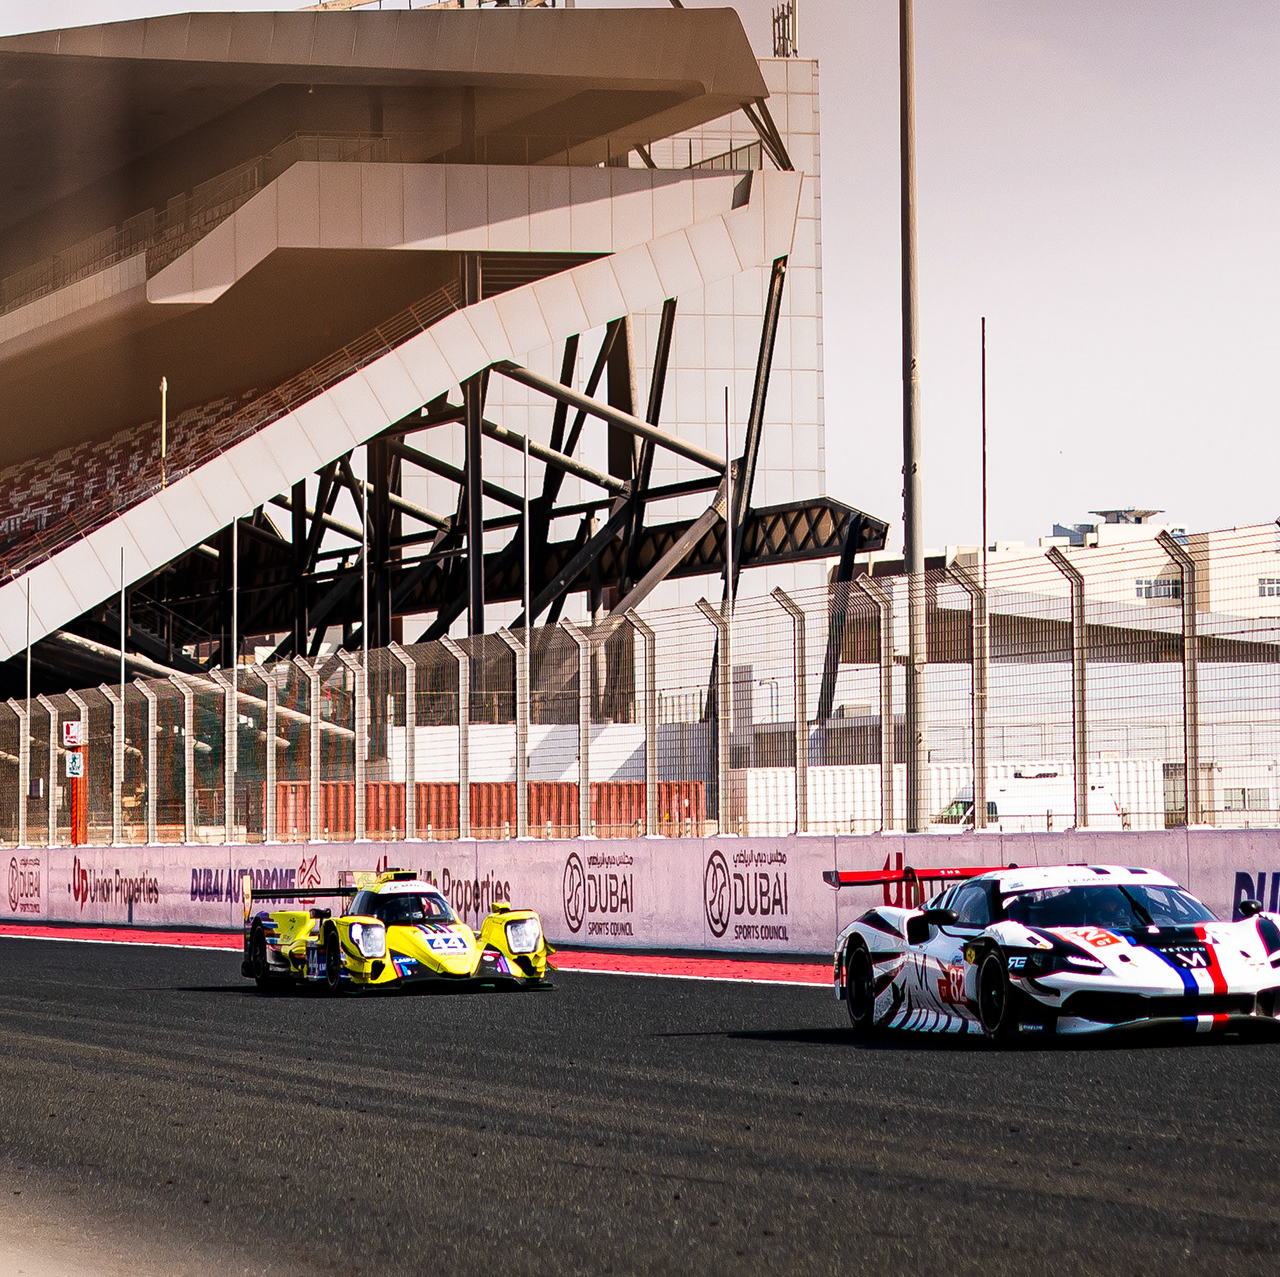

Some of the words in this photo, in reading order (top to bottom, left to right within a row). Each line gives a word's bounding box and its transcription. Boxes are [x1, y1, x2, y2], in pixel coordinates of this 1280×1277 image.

[89, 869, 112, 903] Union
[114, 868, 159, 908] Properties
[191, 868, 224, 902] DUBAI
[442, 868, 511, 923] Properties
[587, 873, 634, 913] DUBAI
[734, 872, 789, 916] DUBAI
[432, 937, 464, 950] 44
[587, 921, 609, 935] SPORTS
[610, 921, 634, 936] COUNCIL
[734, 924, 759, 940] SPORTS
[760, 925, 789, 941] COUNCIL
[950, 967, 967, 1002] 82
